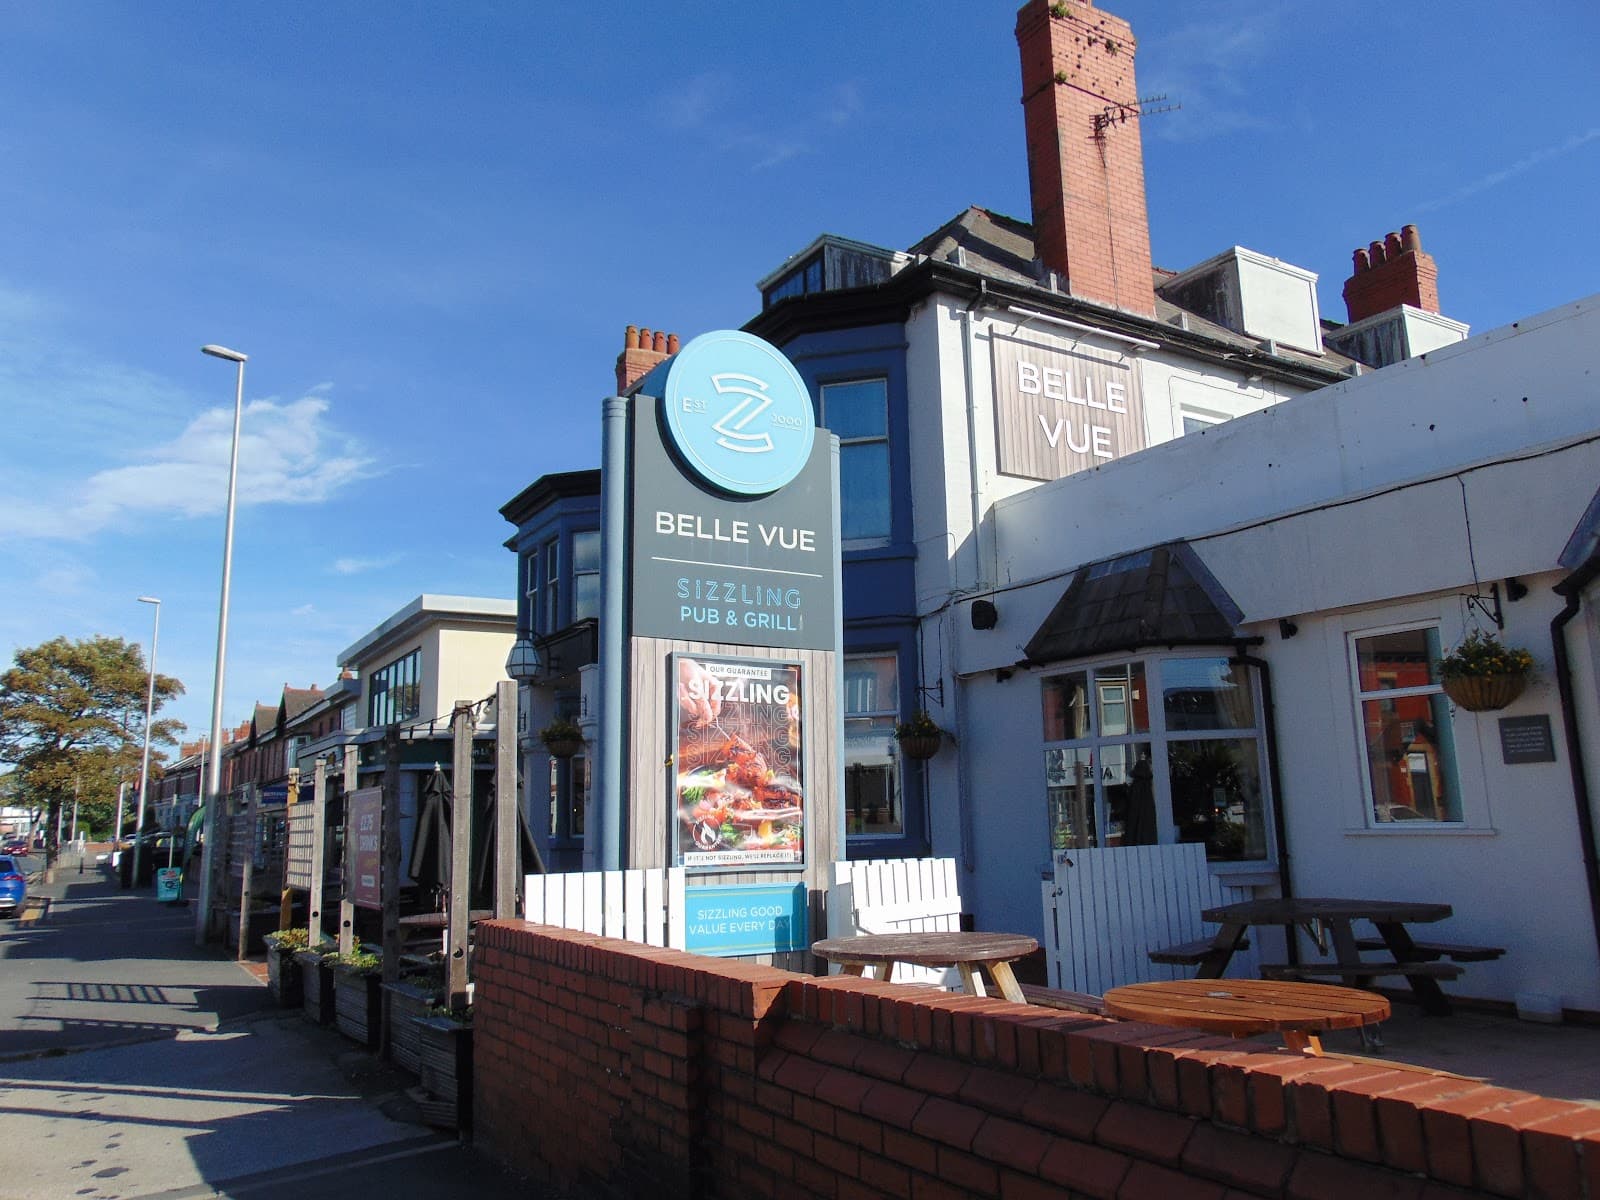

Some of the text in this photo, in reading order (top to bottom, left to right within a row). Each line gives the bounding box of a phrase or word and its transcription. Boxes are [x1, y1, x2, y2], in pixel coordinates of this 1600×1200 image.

[1017, 360, 1127, 414] BELLE
[1038, 414, 1114, 459] VUE
[656, 511, 816, 552] BELLE VUE
[680, 605, 797, 631] PUB & GRILL
[726, 667, 769, 677] GUARANTEE
[688, 679, 790, 704] SIZZLING
[697, 906, 783, 920] SIZZLING GOOD
[689, 918, 790, 935] VALUE EVERY DAY
